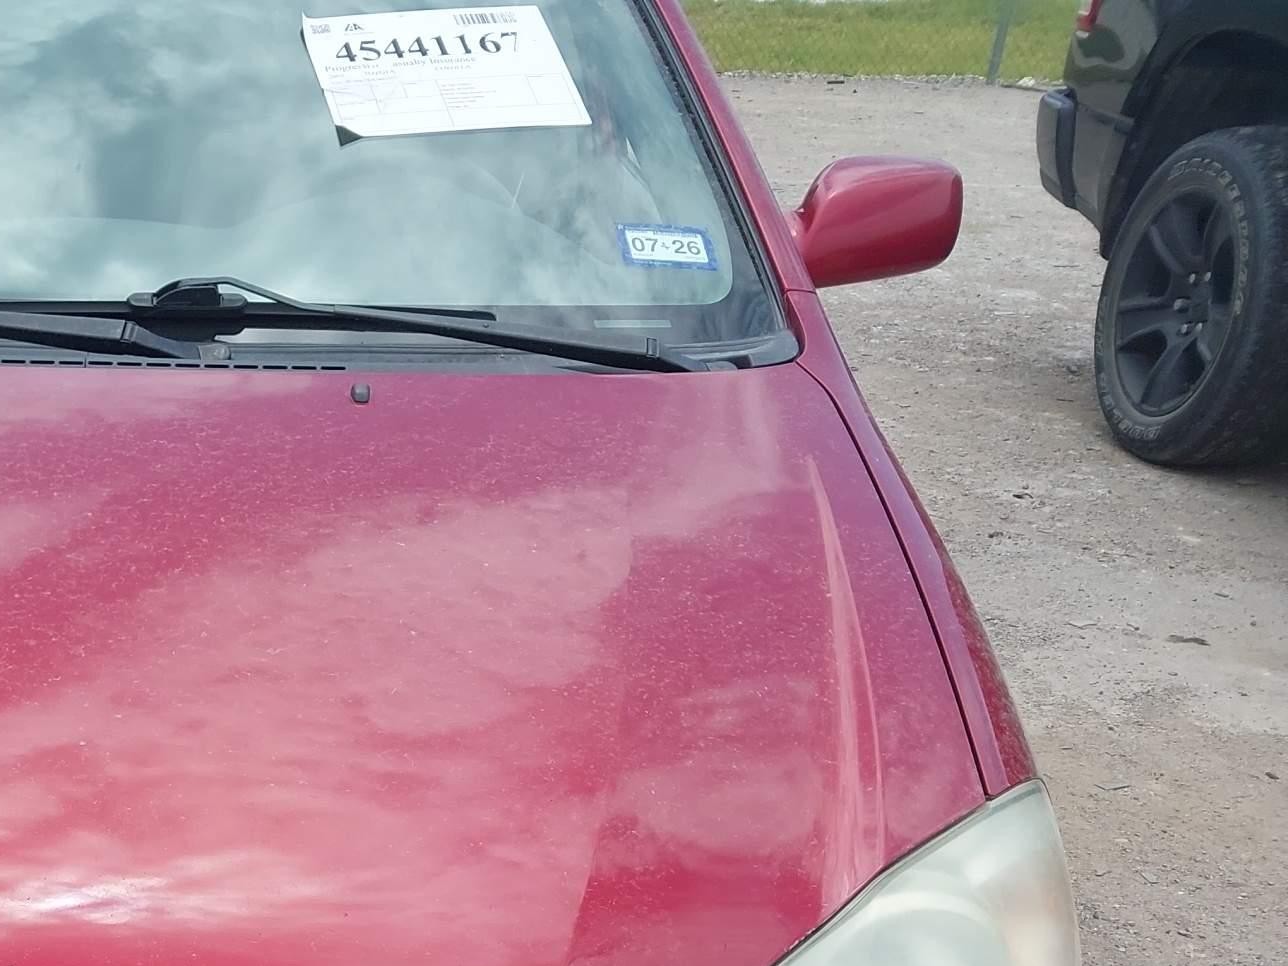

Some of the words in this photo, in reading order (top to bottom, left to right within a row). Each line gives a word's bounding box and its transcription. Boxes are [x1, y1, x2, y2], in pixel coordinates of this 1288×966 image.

[335, 31, 518, 63] 45441167
[631, 237, 658, 252] 07
[672, 240, 701, 256] 26
